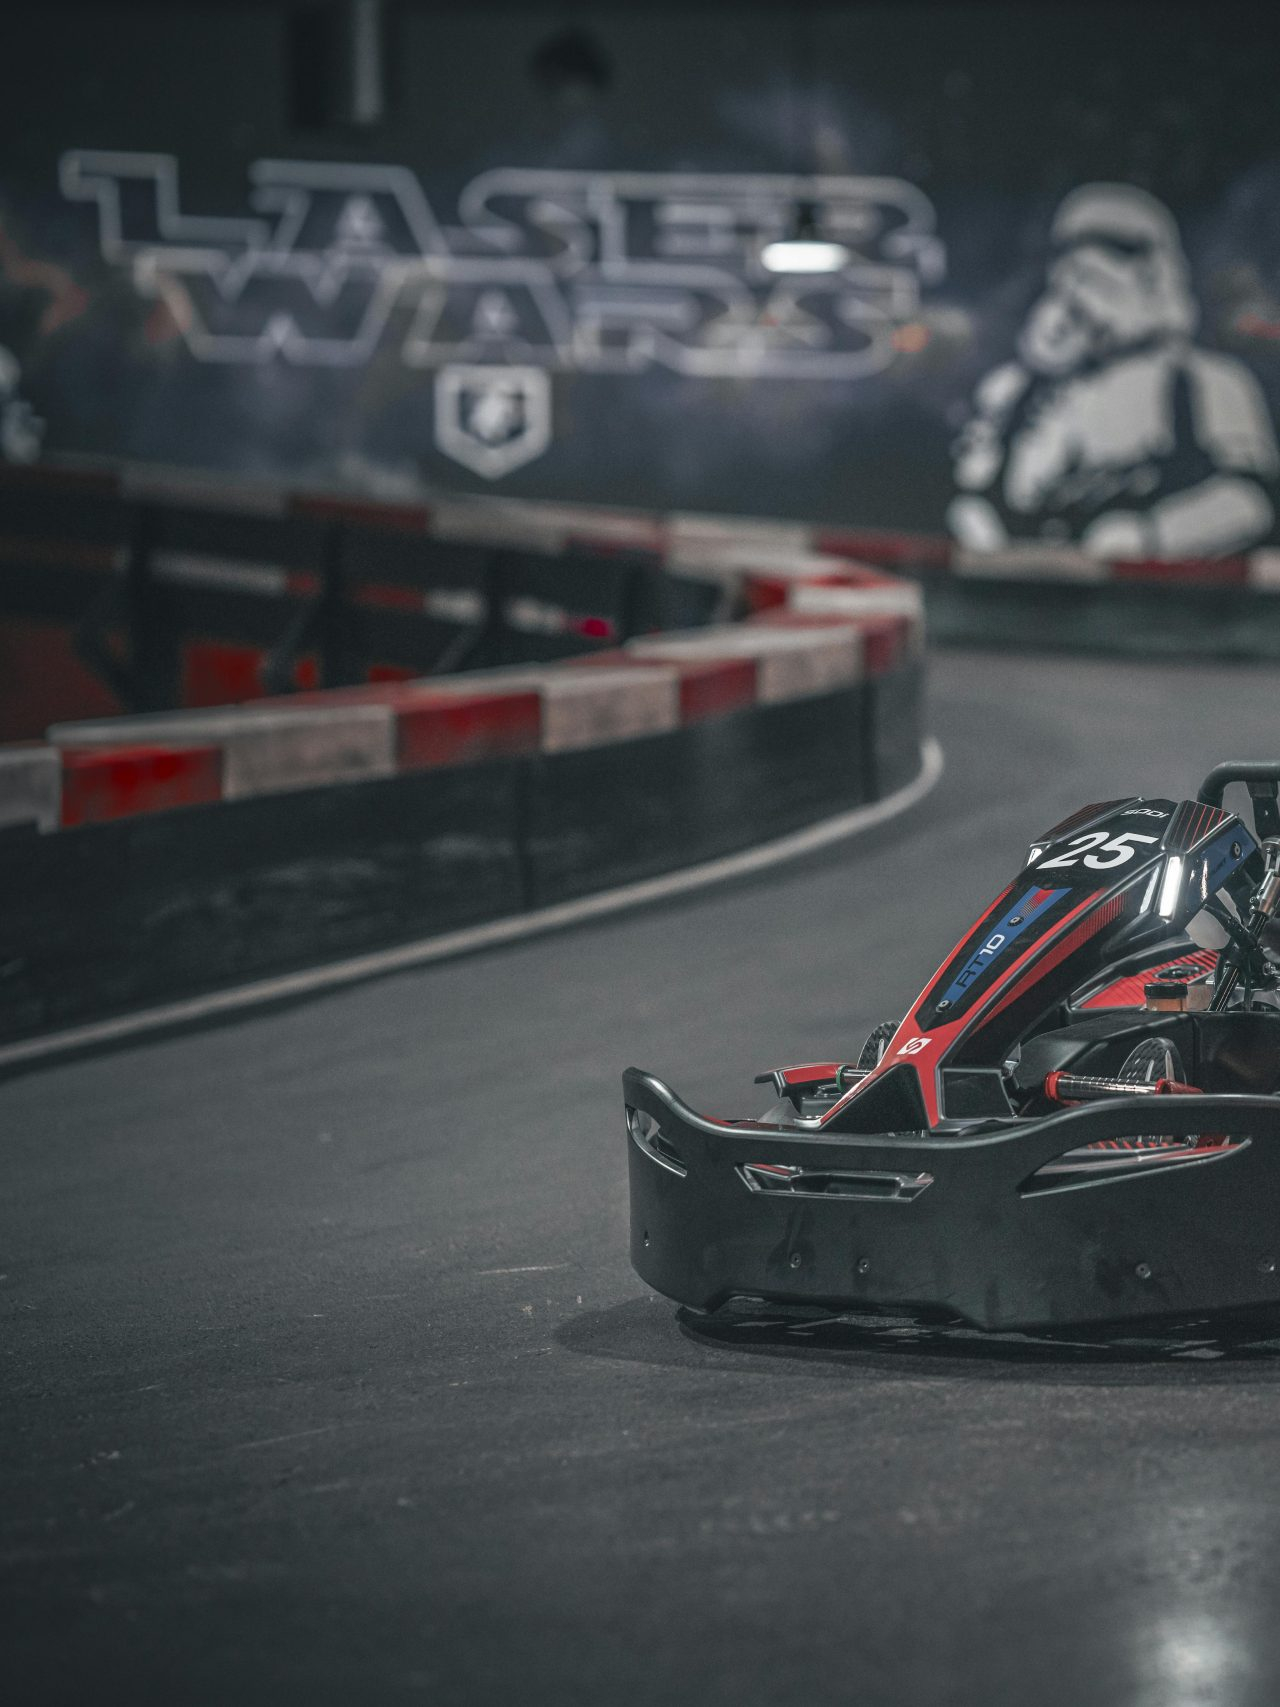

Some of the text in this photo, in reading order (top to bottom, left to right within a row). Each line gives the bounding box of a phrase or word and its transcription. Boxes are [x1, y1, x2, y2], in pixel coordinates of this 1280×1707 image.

[58, 148, 948, 286] LASER
[134, 248, 922, 379] WARS
[1037, 832, 1159, 870] 25
[955, 933, 1006, 988] RT10
